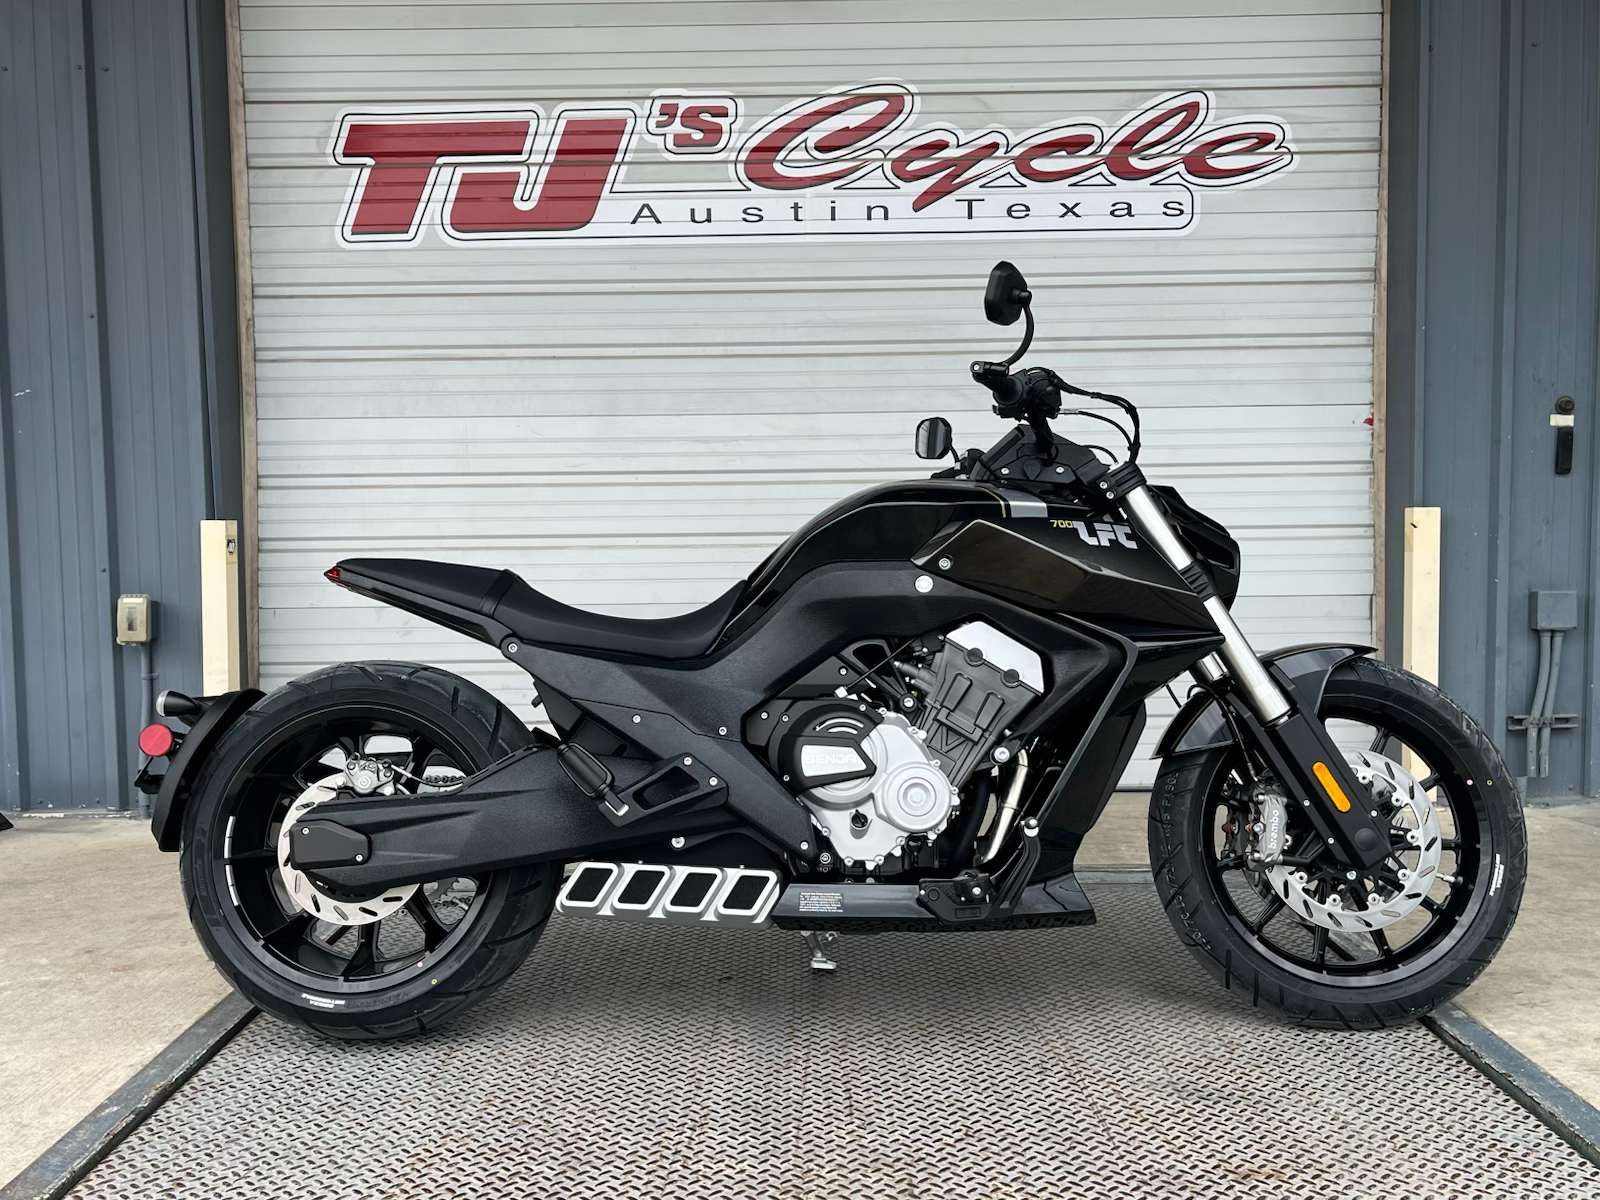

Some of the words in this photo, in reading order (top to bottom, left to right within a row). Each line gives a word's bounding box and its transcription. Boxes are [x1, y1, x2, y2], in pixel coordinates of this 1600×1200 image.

[743, 94, 1284, 213] Cycle
[630, 200, 890, 225] Austin
[955, 198, 1185, 220] Texas
[1050, 519, 1074, 528] 700
[1072, 520, 1138, 549] LFC
[804, 754, 857, 764] BENDA
[1267, 809, 1280, 849] brembo
